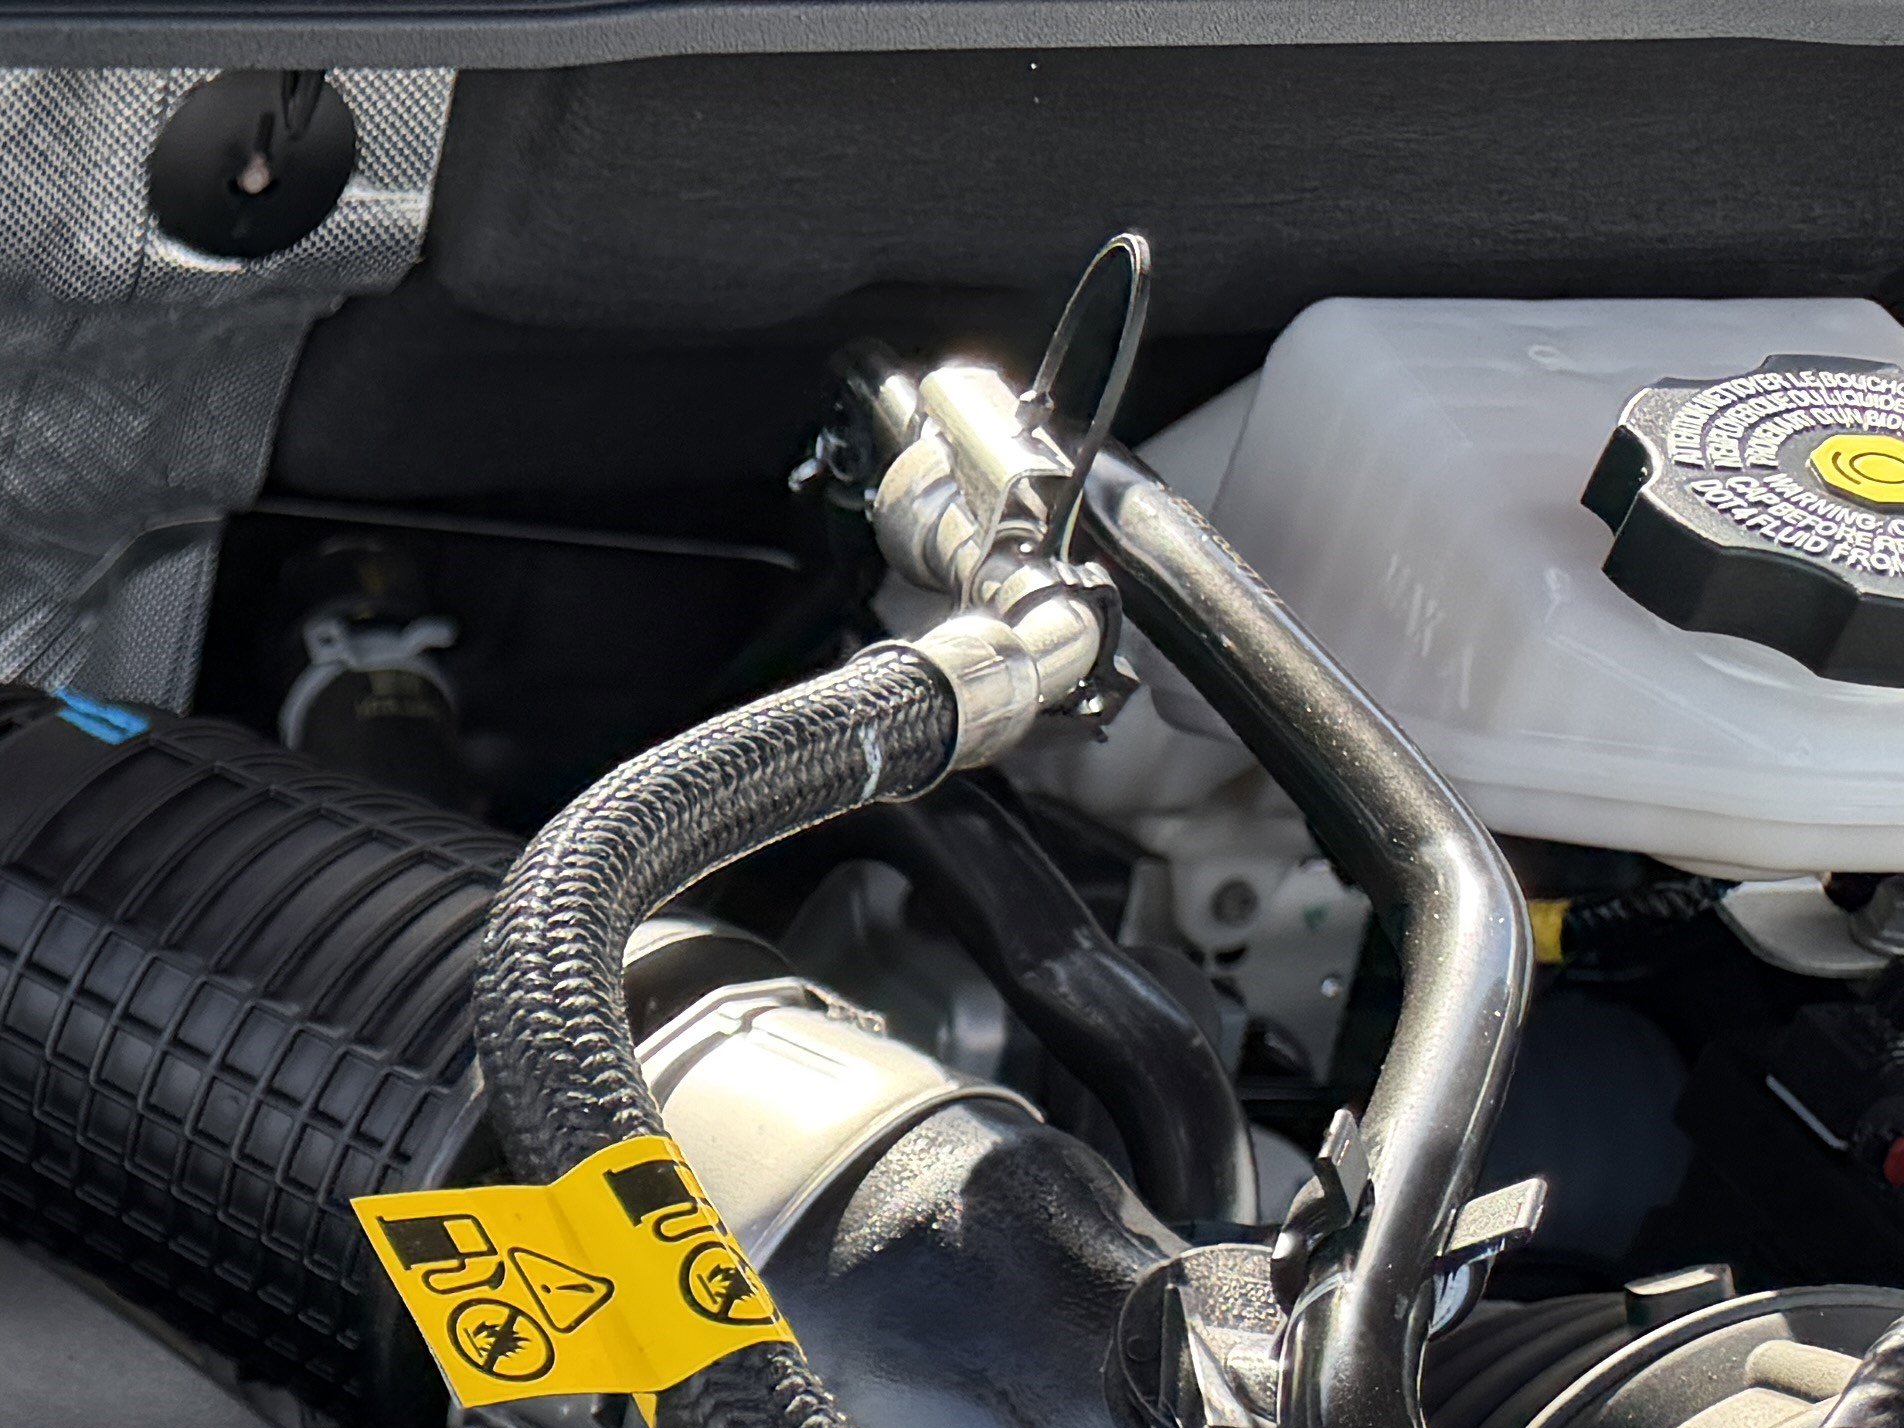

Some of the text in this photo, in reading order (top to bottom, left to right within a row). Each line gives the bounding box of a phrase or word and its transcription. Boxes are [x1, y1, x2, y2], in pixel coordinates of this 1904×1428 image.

[1725, 475, 1780, 505] CAP
[1768, 501, 1876, 549] BEFORE
[1745, 512, 1829, 554] FLUID
